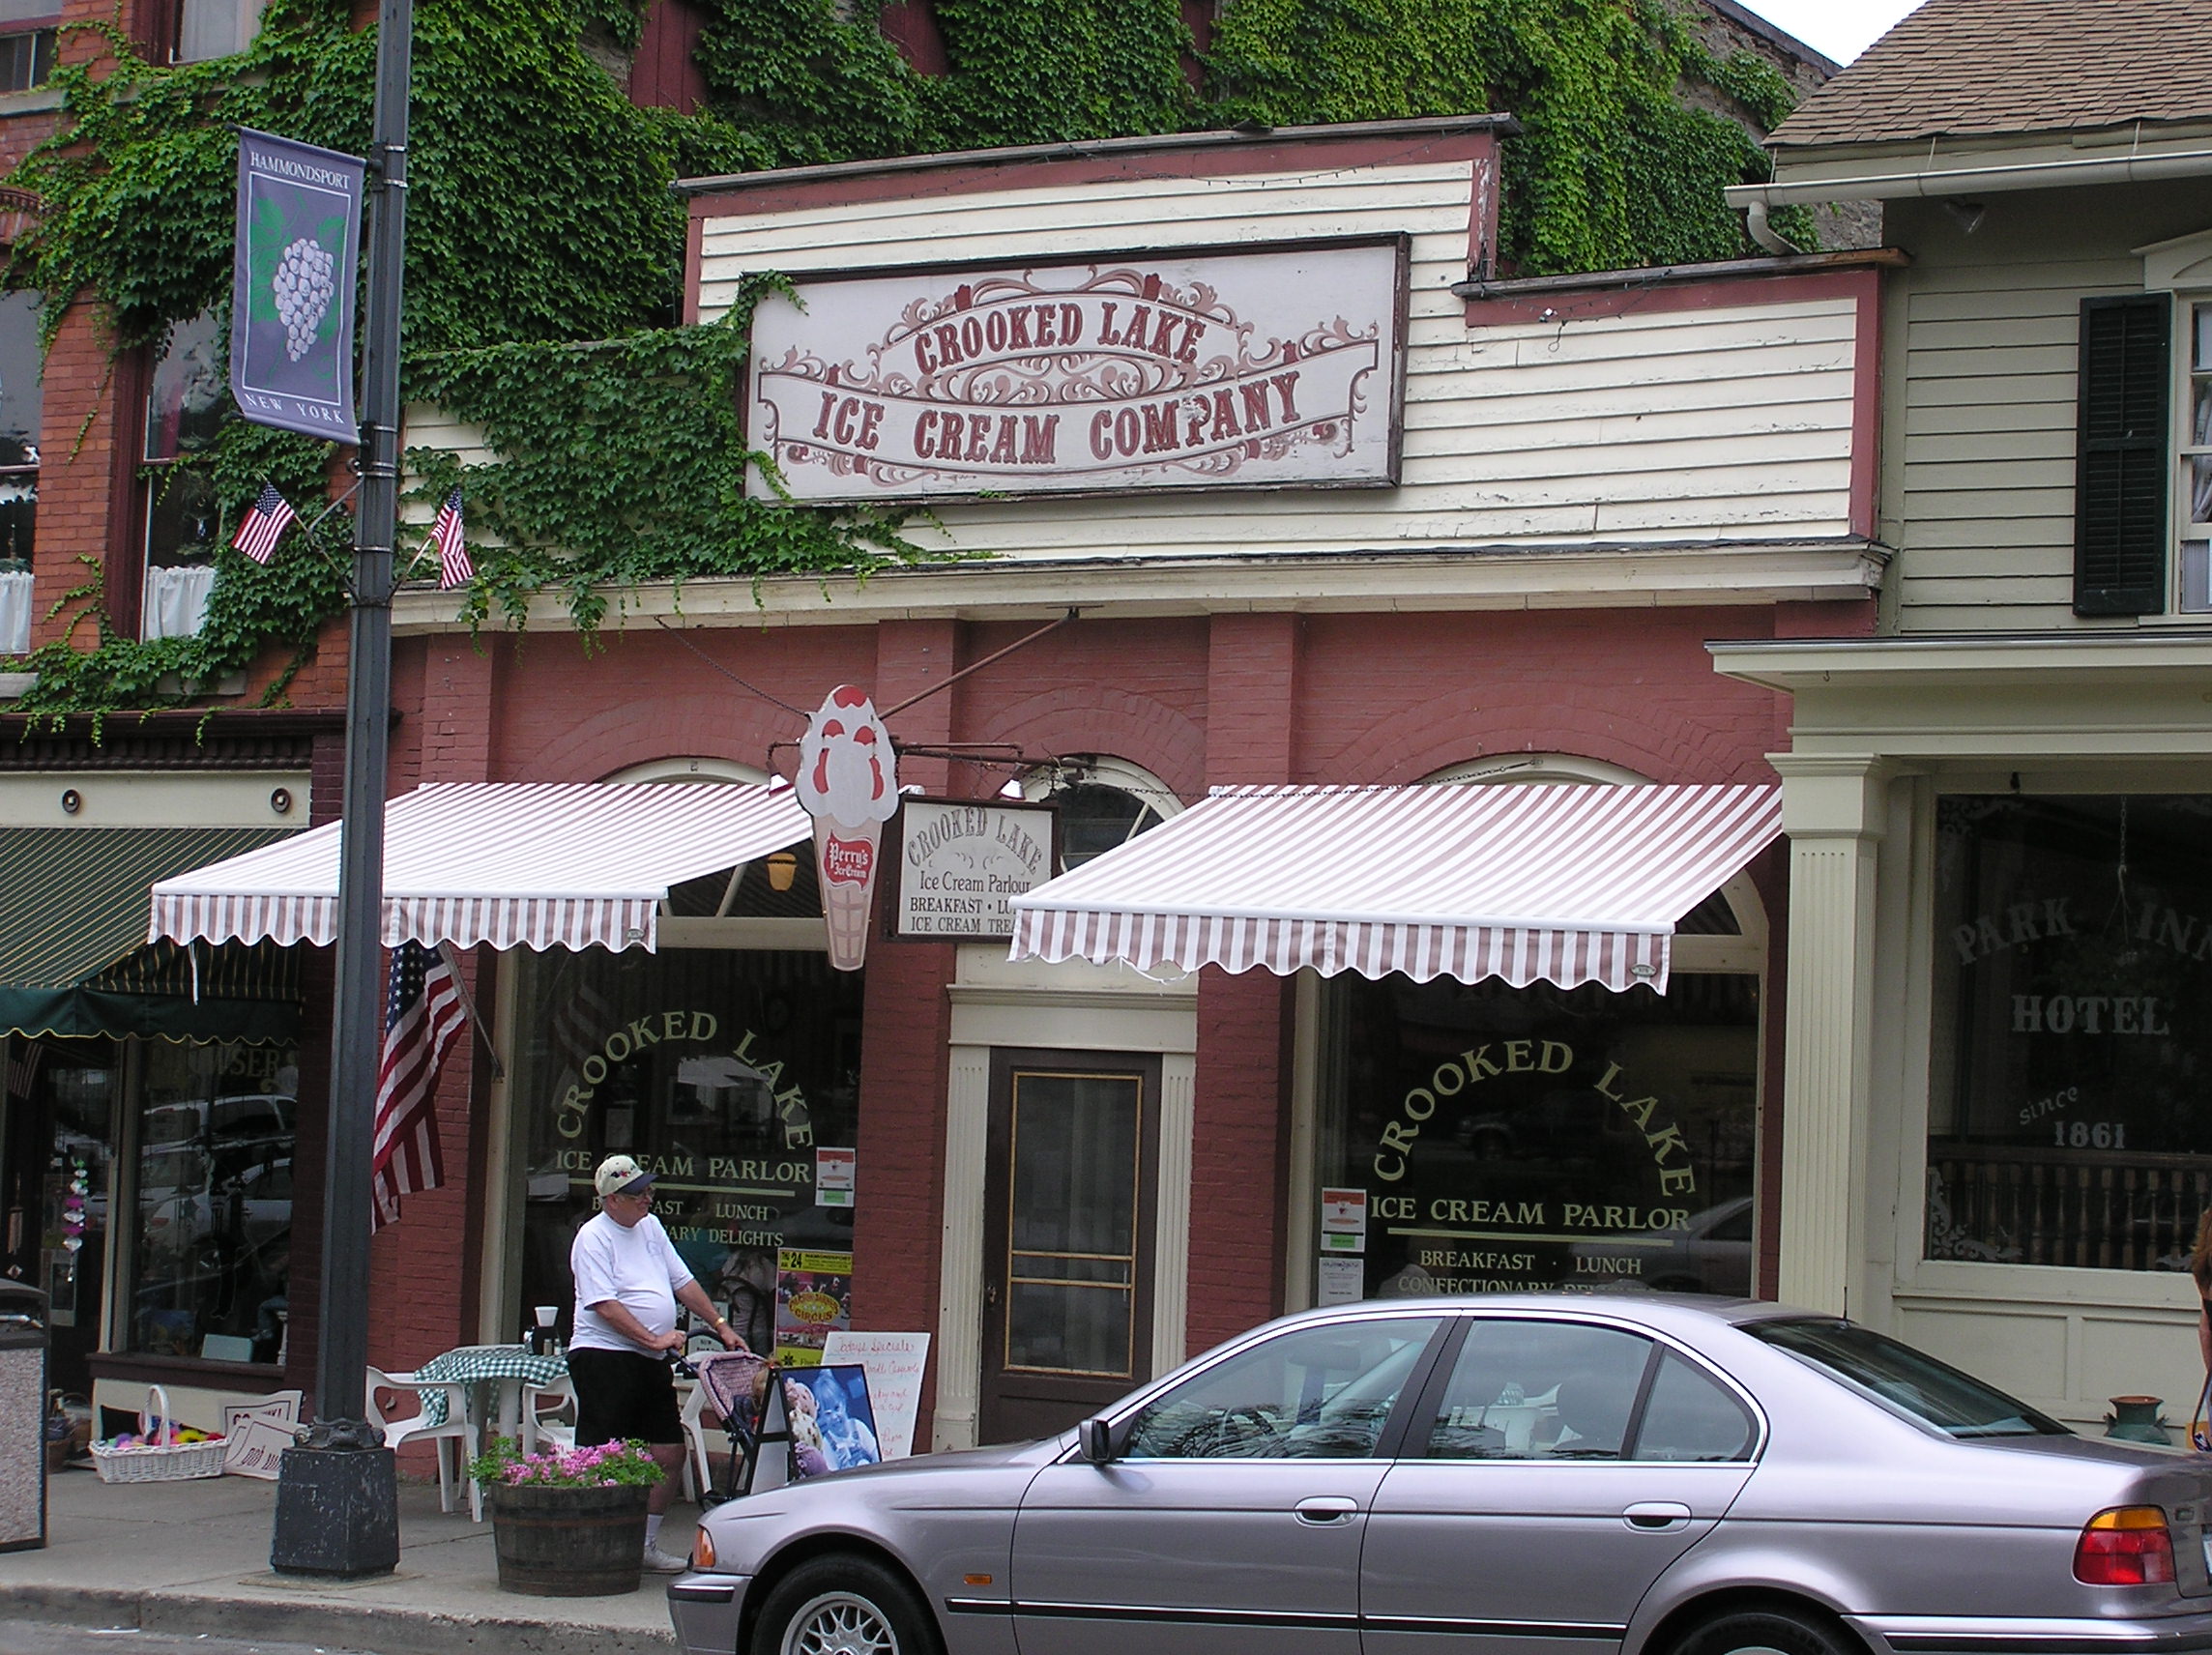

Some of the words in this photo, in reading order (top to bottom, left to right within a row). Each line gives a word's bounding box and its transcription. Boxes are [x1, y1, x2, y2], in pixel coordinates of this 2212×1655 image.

[249, 151, 351, 190] HAMMONDSPORT
[914, 302, 1084, 376] CROOKED
[1096, 302, 1207, 364] LAKE
[244, 392, 283, 411] NEW
[296, 401, 344, 424] YORK
[812, 391, 886, 449] ICE
[913, 409, 1061, 464] CREAM
[1089, 370, 1302, 460] COMPANY
[829, 841, 868, 869] Perry's
[908, 805, 987, 867] CROOKED
[995, 813, 1042, 875] LAKE
[920, 870, 940, 890] Ice
[942, 870, 984, 892] Cream
[988, 874, 1032, 894] Parlour
[910, 897, 983, 915] BREAKFAST
[911, 916, 932, 932] ICE
[938, 916, 981, 933] CREAM
[1951, 897, 2078, 966] PARK
[2012, 995, 2170, 1036] HOTEL
[557, 1010, 718, 1139] CROOKED
[732, 1029, 814, 1150] LAKE
[1374, 1039, 1574, 1181] CROOKED
[1593, 1060, 1697, 1197] LAKE
[2019, 1085, 2079, 1126] since
[2053, 1120, 2125, 1149] 1861
[556, 1150, 593, 1171] ICE
[708, 1157, 812, 1183] PARLOR
[715, 1203, 770, 1221] LUNCH
[1370, 1195, 1417, 1219] ICE
[1430, 1199, 1545, 1225] CREAM
[1562, 1203, 1692, 1232] PARLOR
[709, 1228, 785, 1247] DELIGHTS
[791, 1251, 803, 1269] 24
[1420, 1250, 1536, 1271] BREAKFAST
[1576, 1256, 1643, 1275] LUNCH
